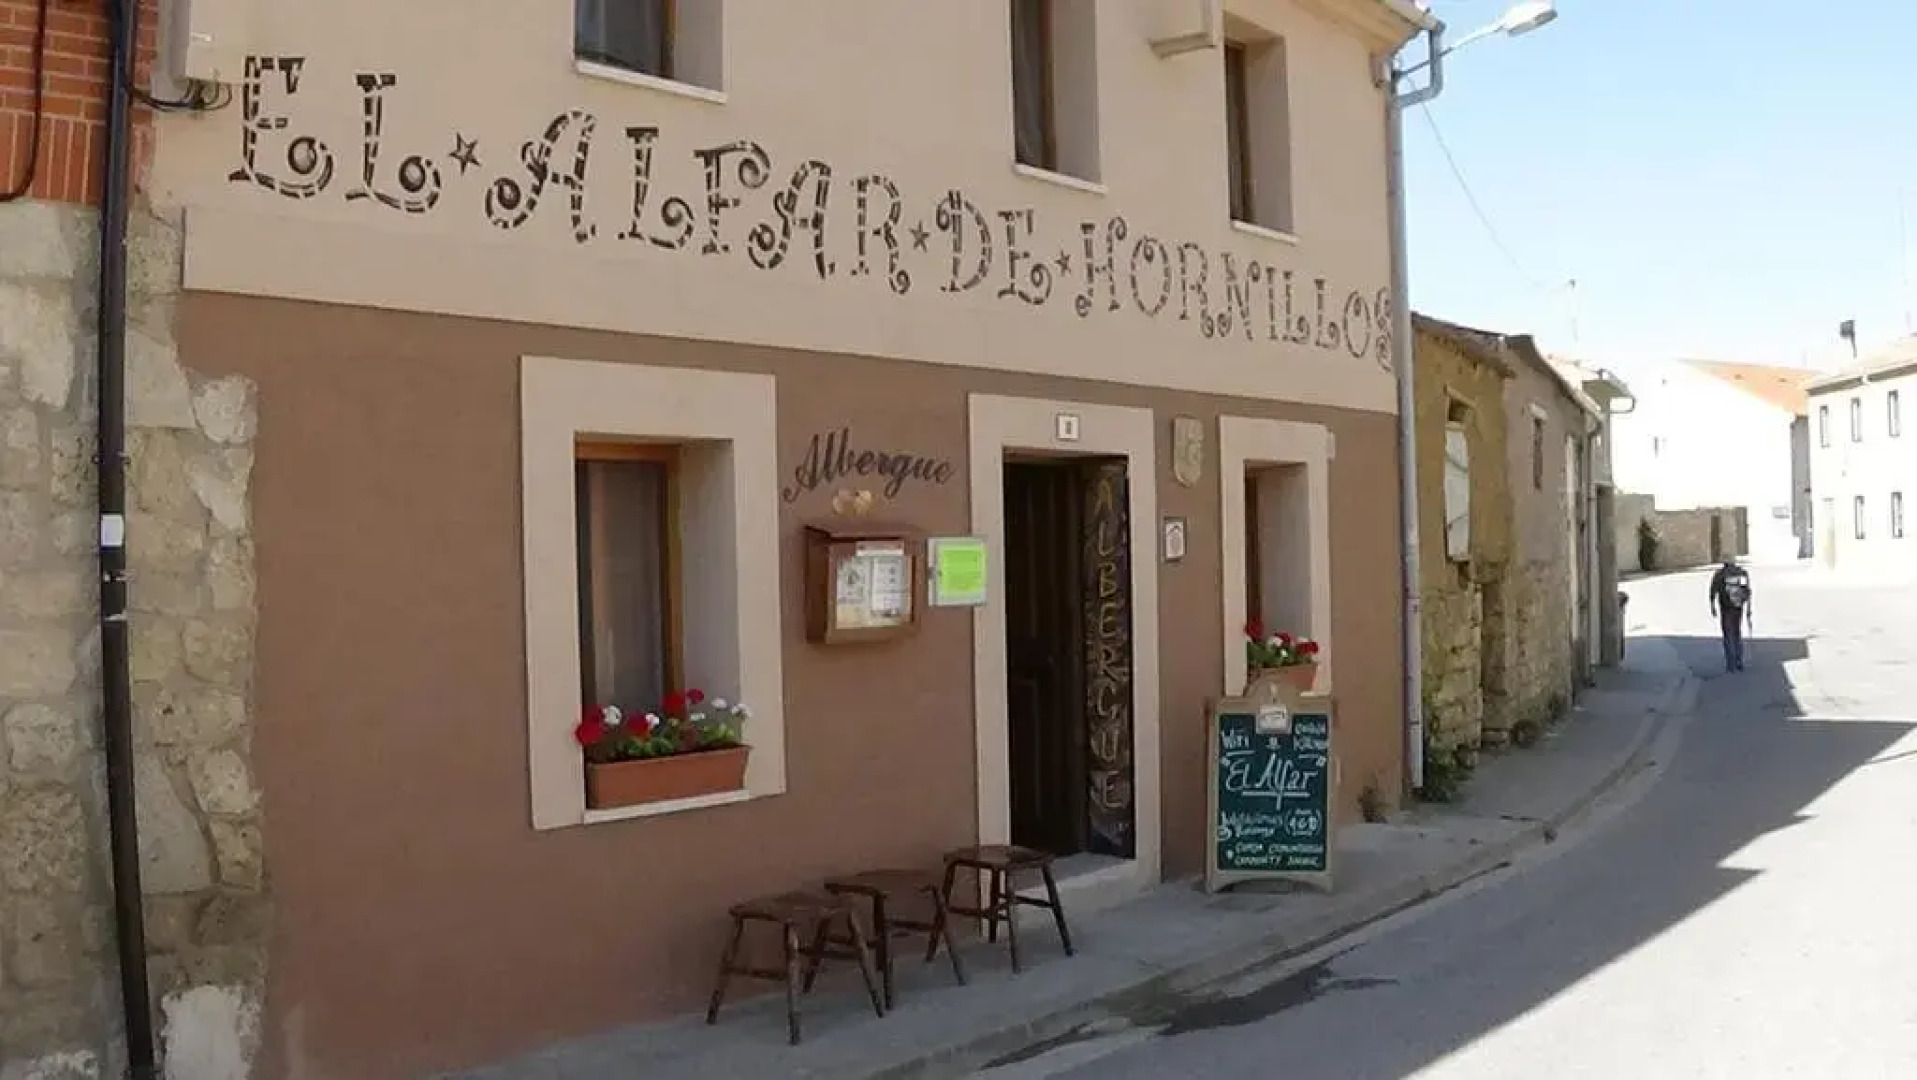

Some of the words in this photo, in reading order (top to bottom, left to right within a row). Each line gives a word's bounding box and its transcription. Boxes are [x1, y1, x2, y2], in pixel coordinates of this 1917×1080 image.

[229, 55, 441, 213] EL
[485, 108, 911, 295] ALFAR
[936, 190, 1053, 306] DE
[1075, 215, 1391, 372] HORNILLOS
[783, 427, 954, 503] Albergue
